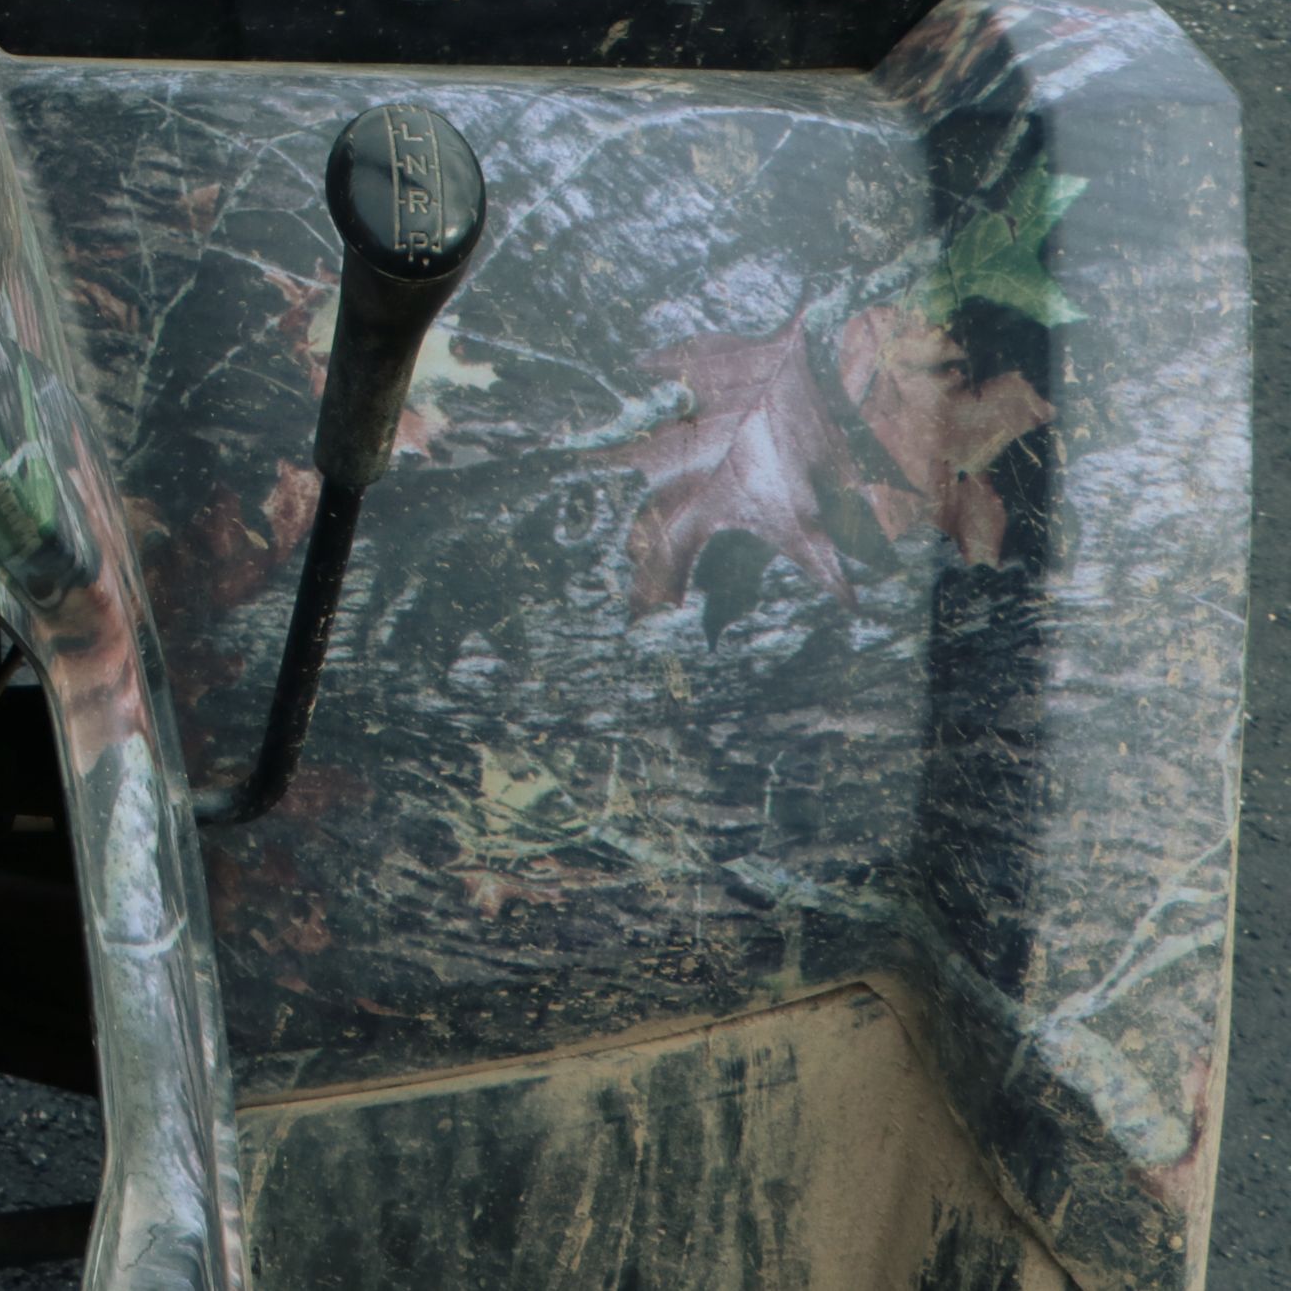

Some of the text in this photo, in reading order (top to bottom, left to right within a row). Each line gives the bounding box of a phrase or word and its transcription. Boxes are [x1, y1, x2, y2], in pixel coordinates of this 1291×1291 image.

[401, 123, 424, 141] L
[405, 154, 427, 175] N
[409, 189, 428, 213] R
